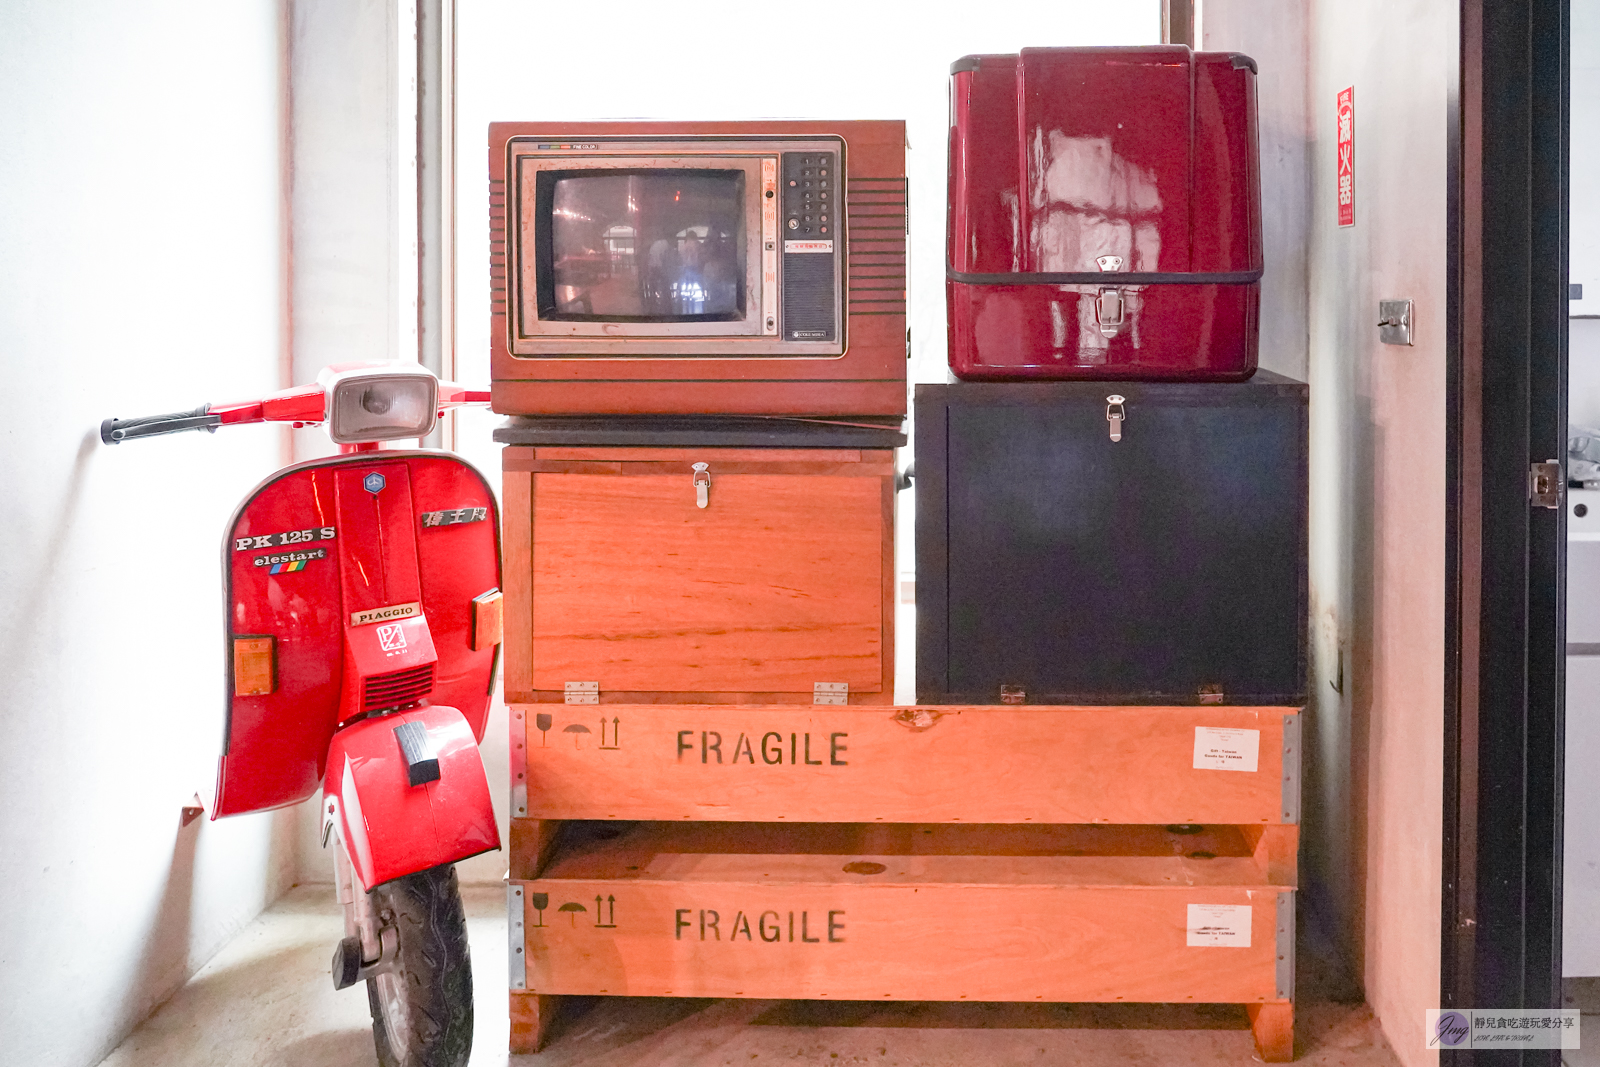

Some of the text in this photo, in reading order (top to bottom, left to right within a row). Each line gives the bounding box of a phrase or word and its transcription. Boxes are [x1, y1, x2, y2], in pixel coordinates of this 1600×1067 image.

[1339, 111, 1351, 205] 滅火器
[236, 526, 336, 551] PK 125 S
[254, 549, 324, 566] elestart
[359, 607, 413, 622] PIAGGIO
[677, 730, 848, 766] FRAGILE
[675, 909, 846, 942] FRAGILE
